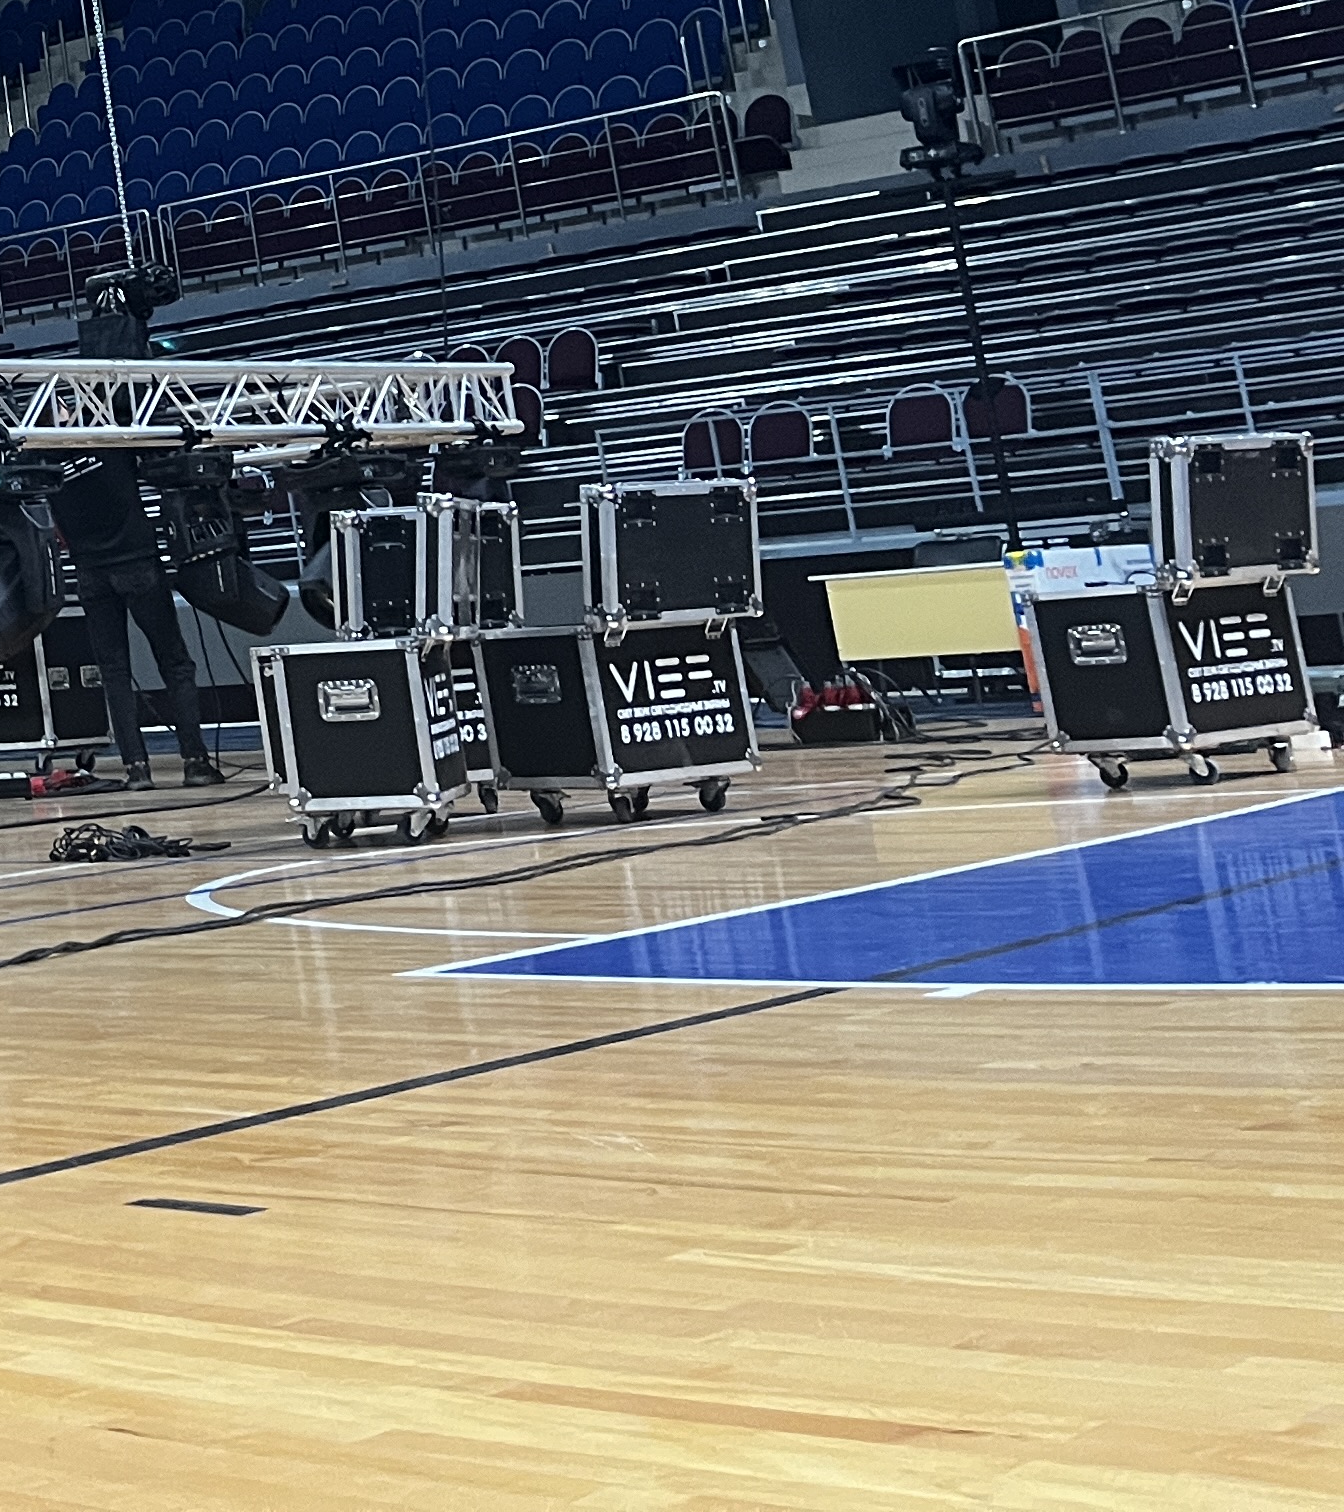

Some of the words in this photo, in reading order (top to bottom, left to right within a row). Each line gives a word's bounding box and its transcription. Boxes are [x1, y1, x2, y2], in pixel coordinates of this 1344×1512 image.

[1230, 677, 1254, 697] 115
[1255, 674, 1274, 694] 00
[1274, 673, 1293, 692] 32
[3, 693, 19, 707] 32
[620, 724, 631, 744] 8
[633, 721, 662, 742] 928
[664, 717, 690, 738] 115
[694, 715, 713, 736] 00
[715, 713, 734, 733] 32
